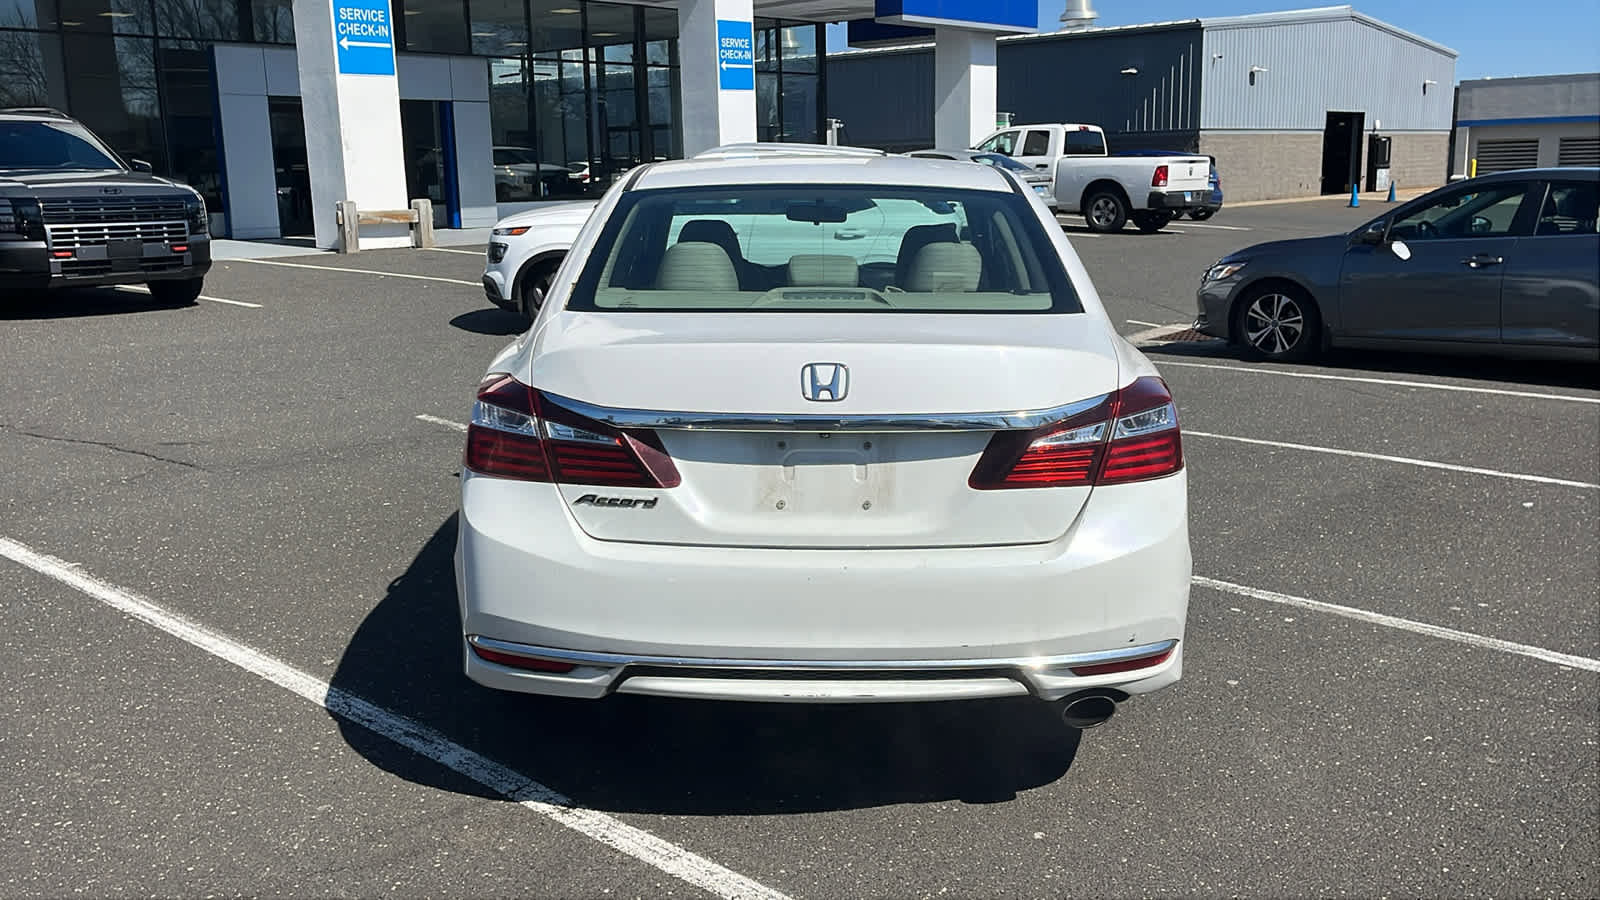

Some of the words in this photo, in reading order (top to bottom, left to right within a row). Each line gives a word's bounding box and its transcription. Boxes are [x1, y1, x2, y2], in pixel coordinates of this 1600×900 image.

[339, 7, 385, 22] SERVICE
[338, 22, 389, 37] CHECK-IN
[721, 38, 750, 48] SERVICE
[720, 49, 752, 60] CHECK-IN
[573, 494, 659, 509] Accord
